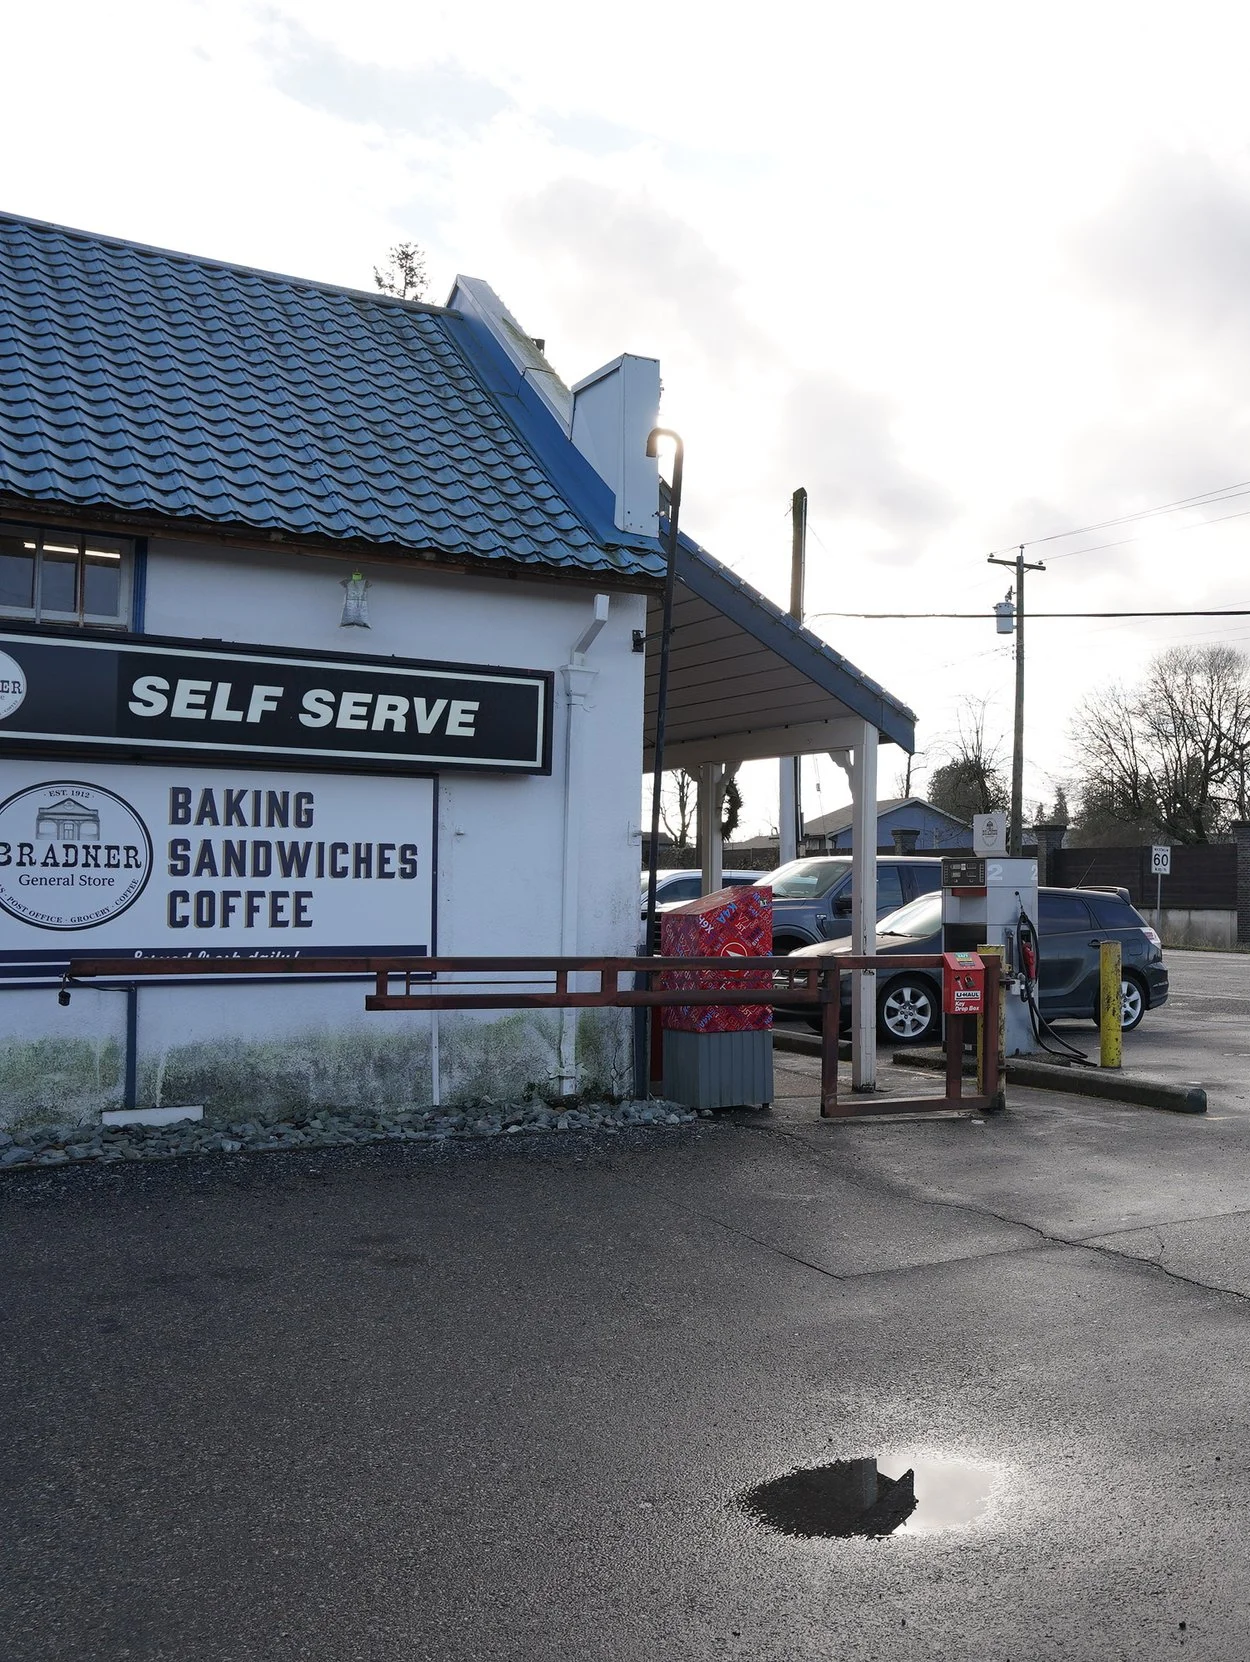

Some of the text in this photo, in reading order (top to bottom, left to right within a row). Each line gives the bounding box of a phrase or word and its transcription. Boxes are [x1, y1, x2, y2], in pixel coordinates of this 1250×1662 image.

[0, 679, 22, 694] ER
[128, 675, 480, 737] SELF SERVE
[49, 789, 90, 798] EST. 1912
[168, 786, 314, 828] BAKING
[0, 842, 142, 869] BRADNER
[168, 838, 418, 880] SANDWICHES
[1154, 853, 1168, 866] 60
[18, 874, 115, 886] General Store
[987, 864, 1003, 881] 2
[7, 878, 140, 923] POST OFFICE GROCERY COFFEE
[167, 889, 314, 929] COFFEE
